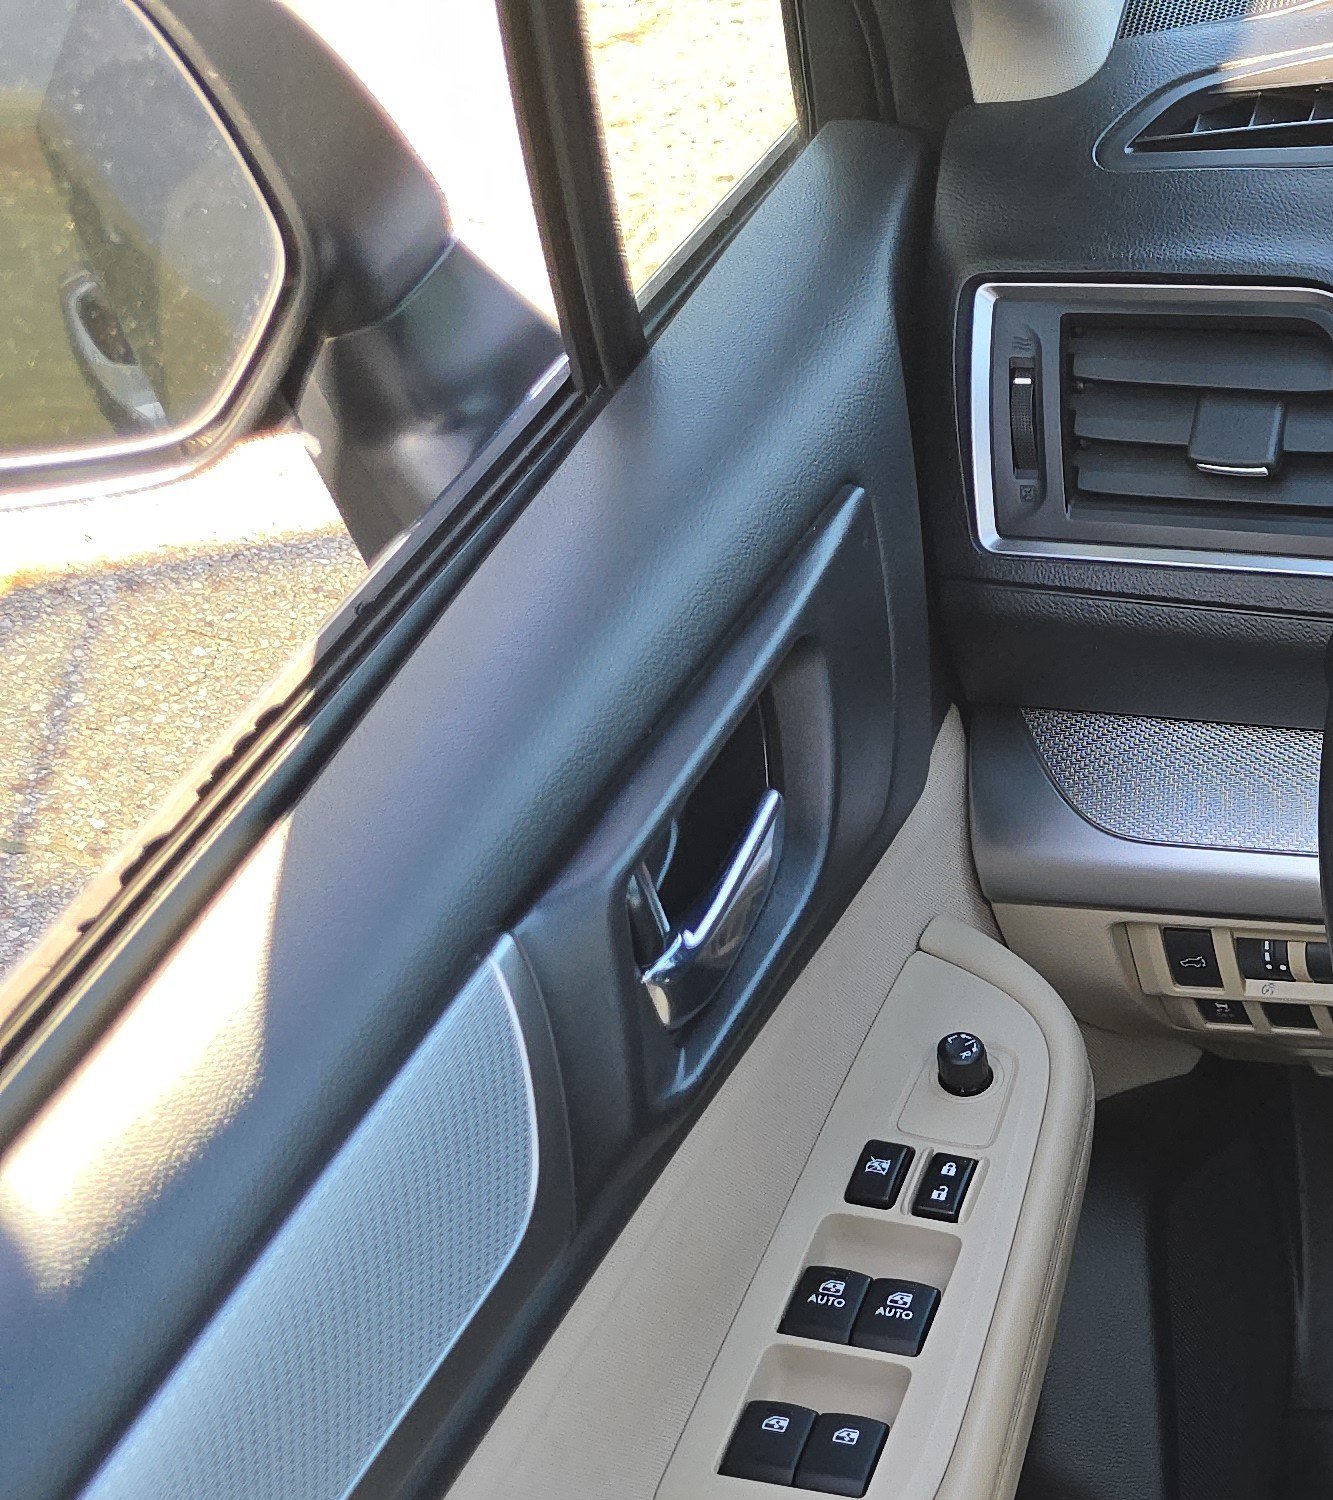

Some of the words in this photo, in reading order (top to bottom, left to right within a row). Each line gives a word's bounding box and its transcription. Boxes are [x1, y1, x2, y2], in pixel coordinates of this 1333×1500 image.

[960, 1050, 972, 1059] R
[807, 1294, 846, 1308] AUTO
[875, 1306, 914, 1320] AUTO
